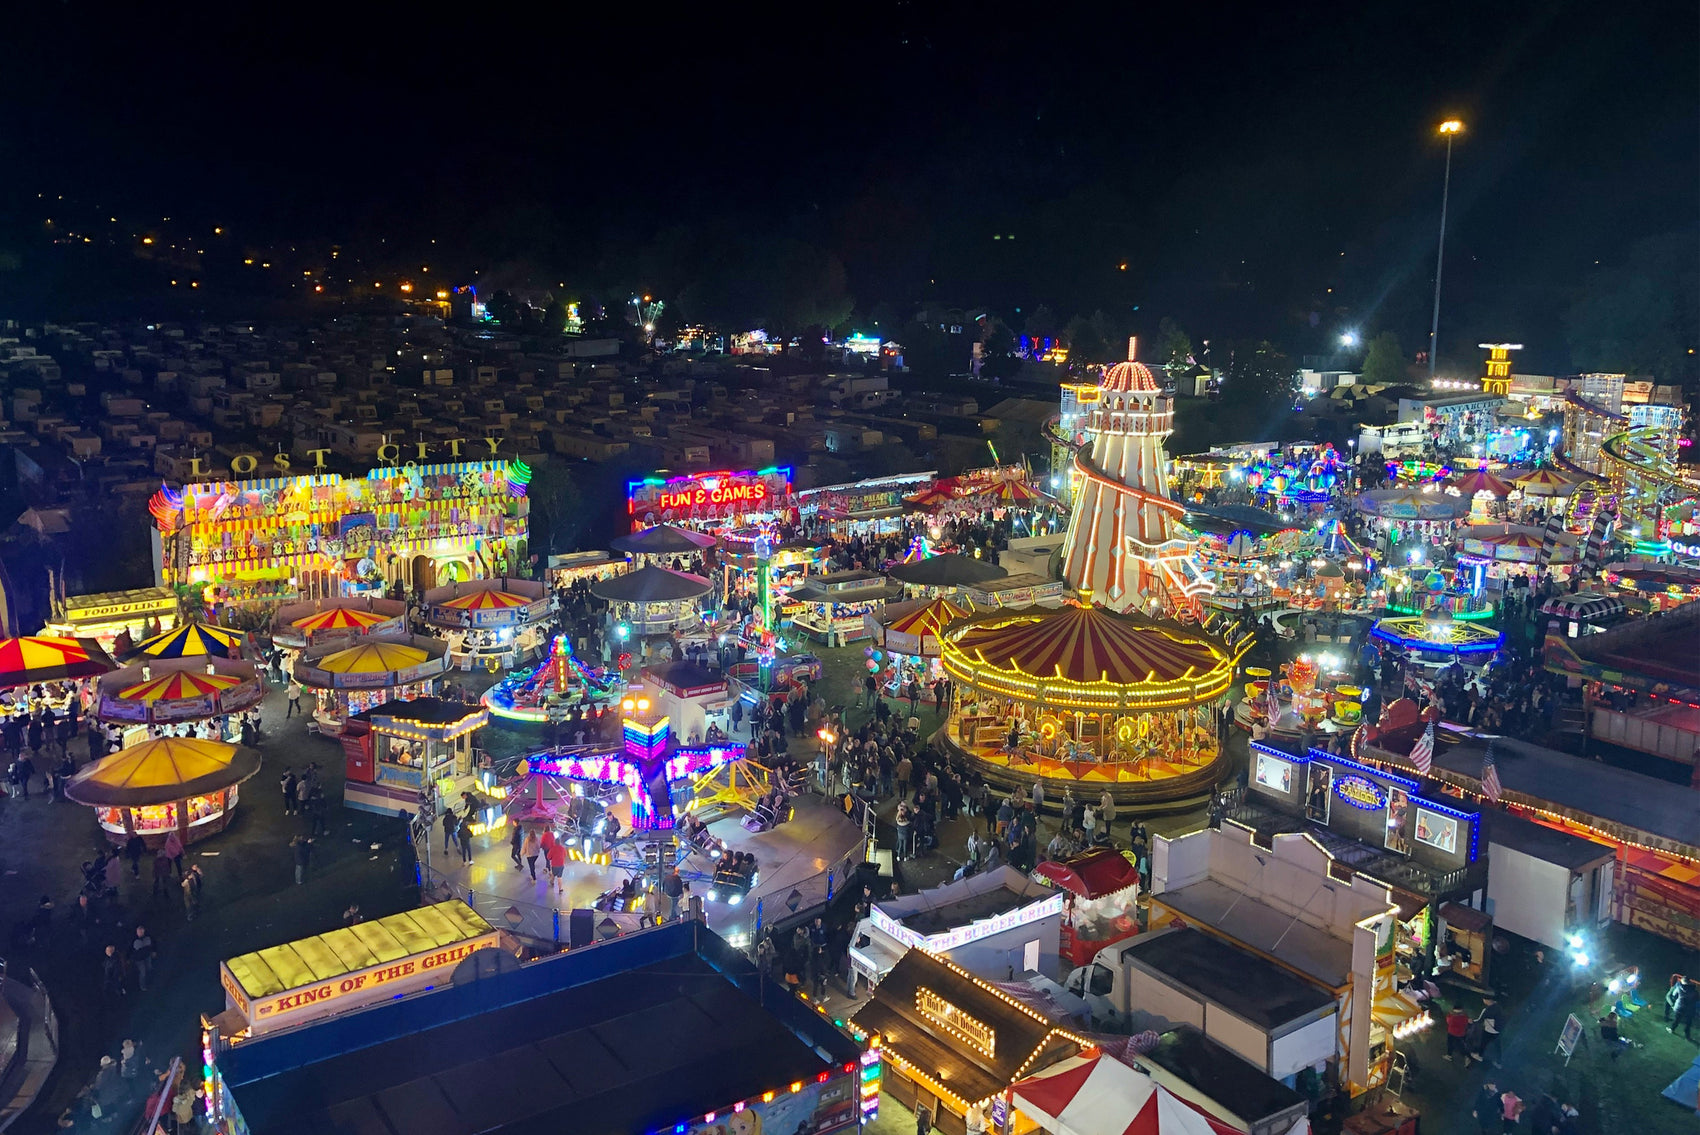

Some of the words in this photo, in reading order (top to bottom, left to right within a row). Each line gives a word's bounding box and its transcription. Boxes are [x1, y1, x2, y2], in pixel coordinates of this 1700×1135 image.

[1441, 400, 1503, 414] ANTARCTICA
[189, 449, 331, 476] LOST
[377, 437, 504, 466] CITY
[660, 492, 691, 508] FUN
[695, 489, 706, 504] &
[711, 483, 765, 503] GAMES
[84, 607, 118, 617] FOOD
[134, 600, 164, 610] LIKE
[1340, 785, 1380, 806] SALOON
[880, 917, 915, 947] CHIPS
[932, 936, 959, 950] THE
[964, 914, 1016, 938] BURGER
[1019, 903, 1055, 923] GRILL
[277, 985, 332, 1012] KING
[340, 975, 367, 993] OF
[374, 962, 415, 983] THE
[422, 943, 475, 969] GRILL
[223, 974, 248, 1013] CHIPS
[960, 1016, 985, 1042] Donuts
